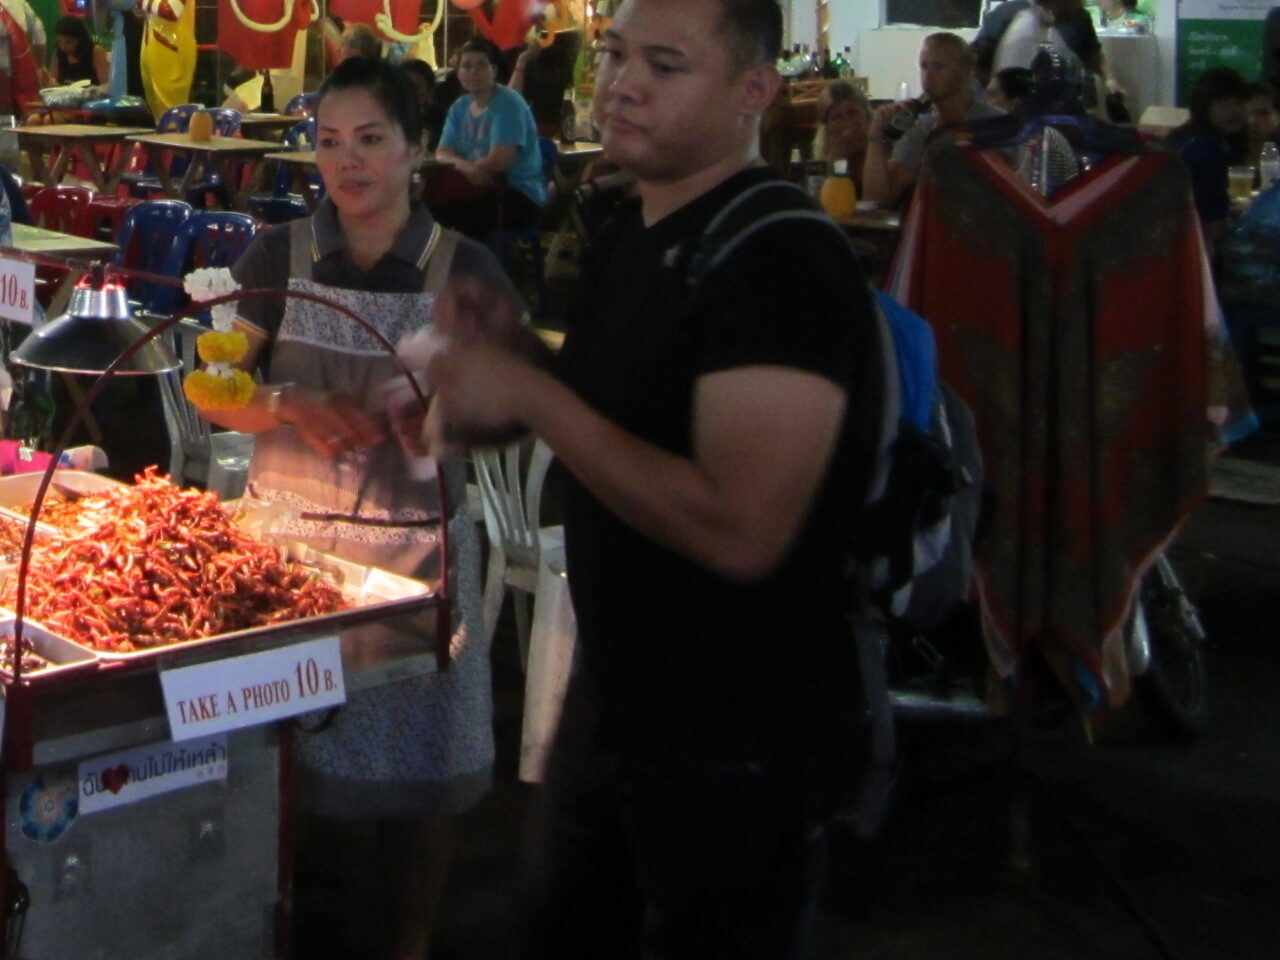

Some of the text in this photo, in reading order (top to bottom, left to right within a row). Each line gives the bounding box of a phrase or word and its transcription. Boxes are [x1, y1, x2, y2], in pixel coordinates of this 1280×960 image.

[1, 273, 18, 307] 10
[177, 694, 221, 725] TAKE
[226, 691, 238, 715] A
[242, 679, 290, 711] PHOTO
[294, 658, 320, 699] 10
